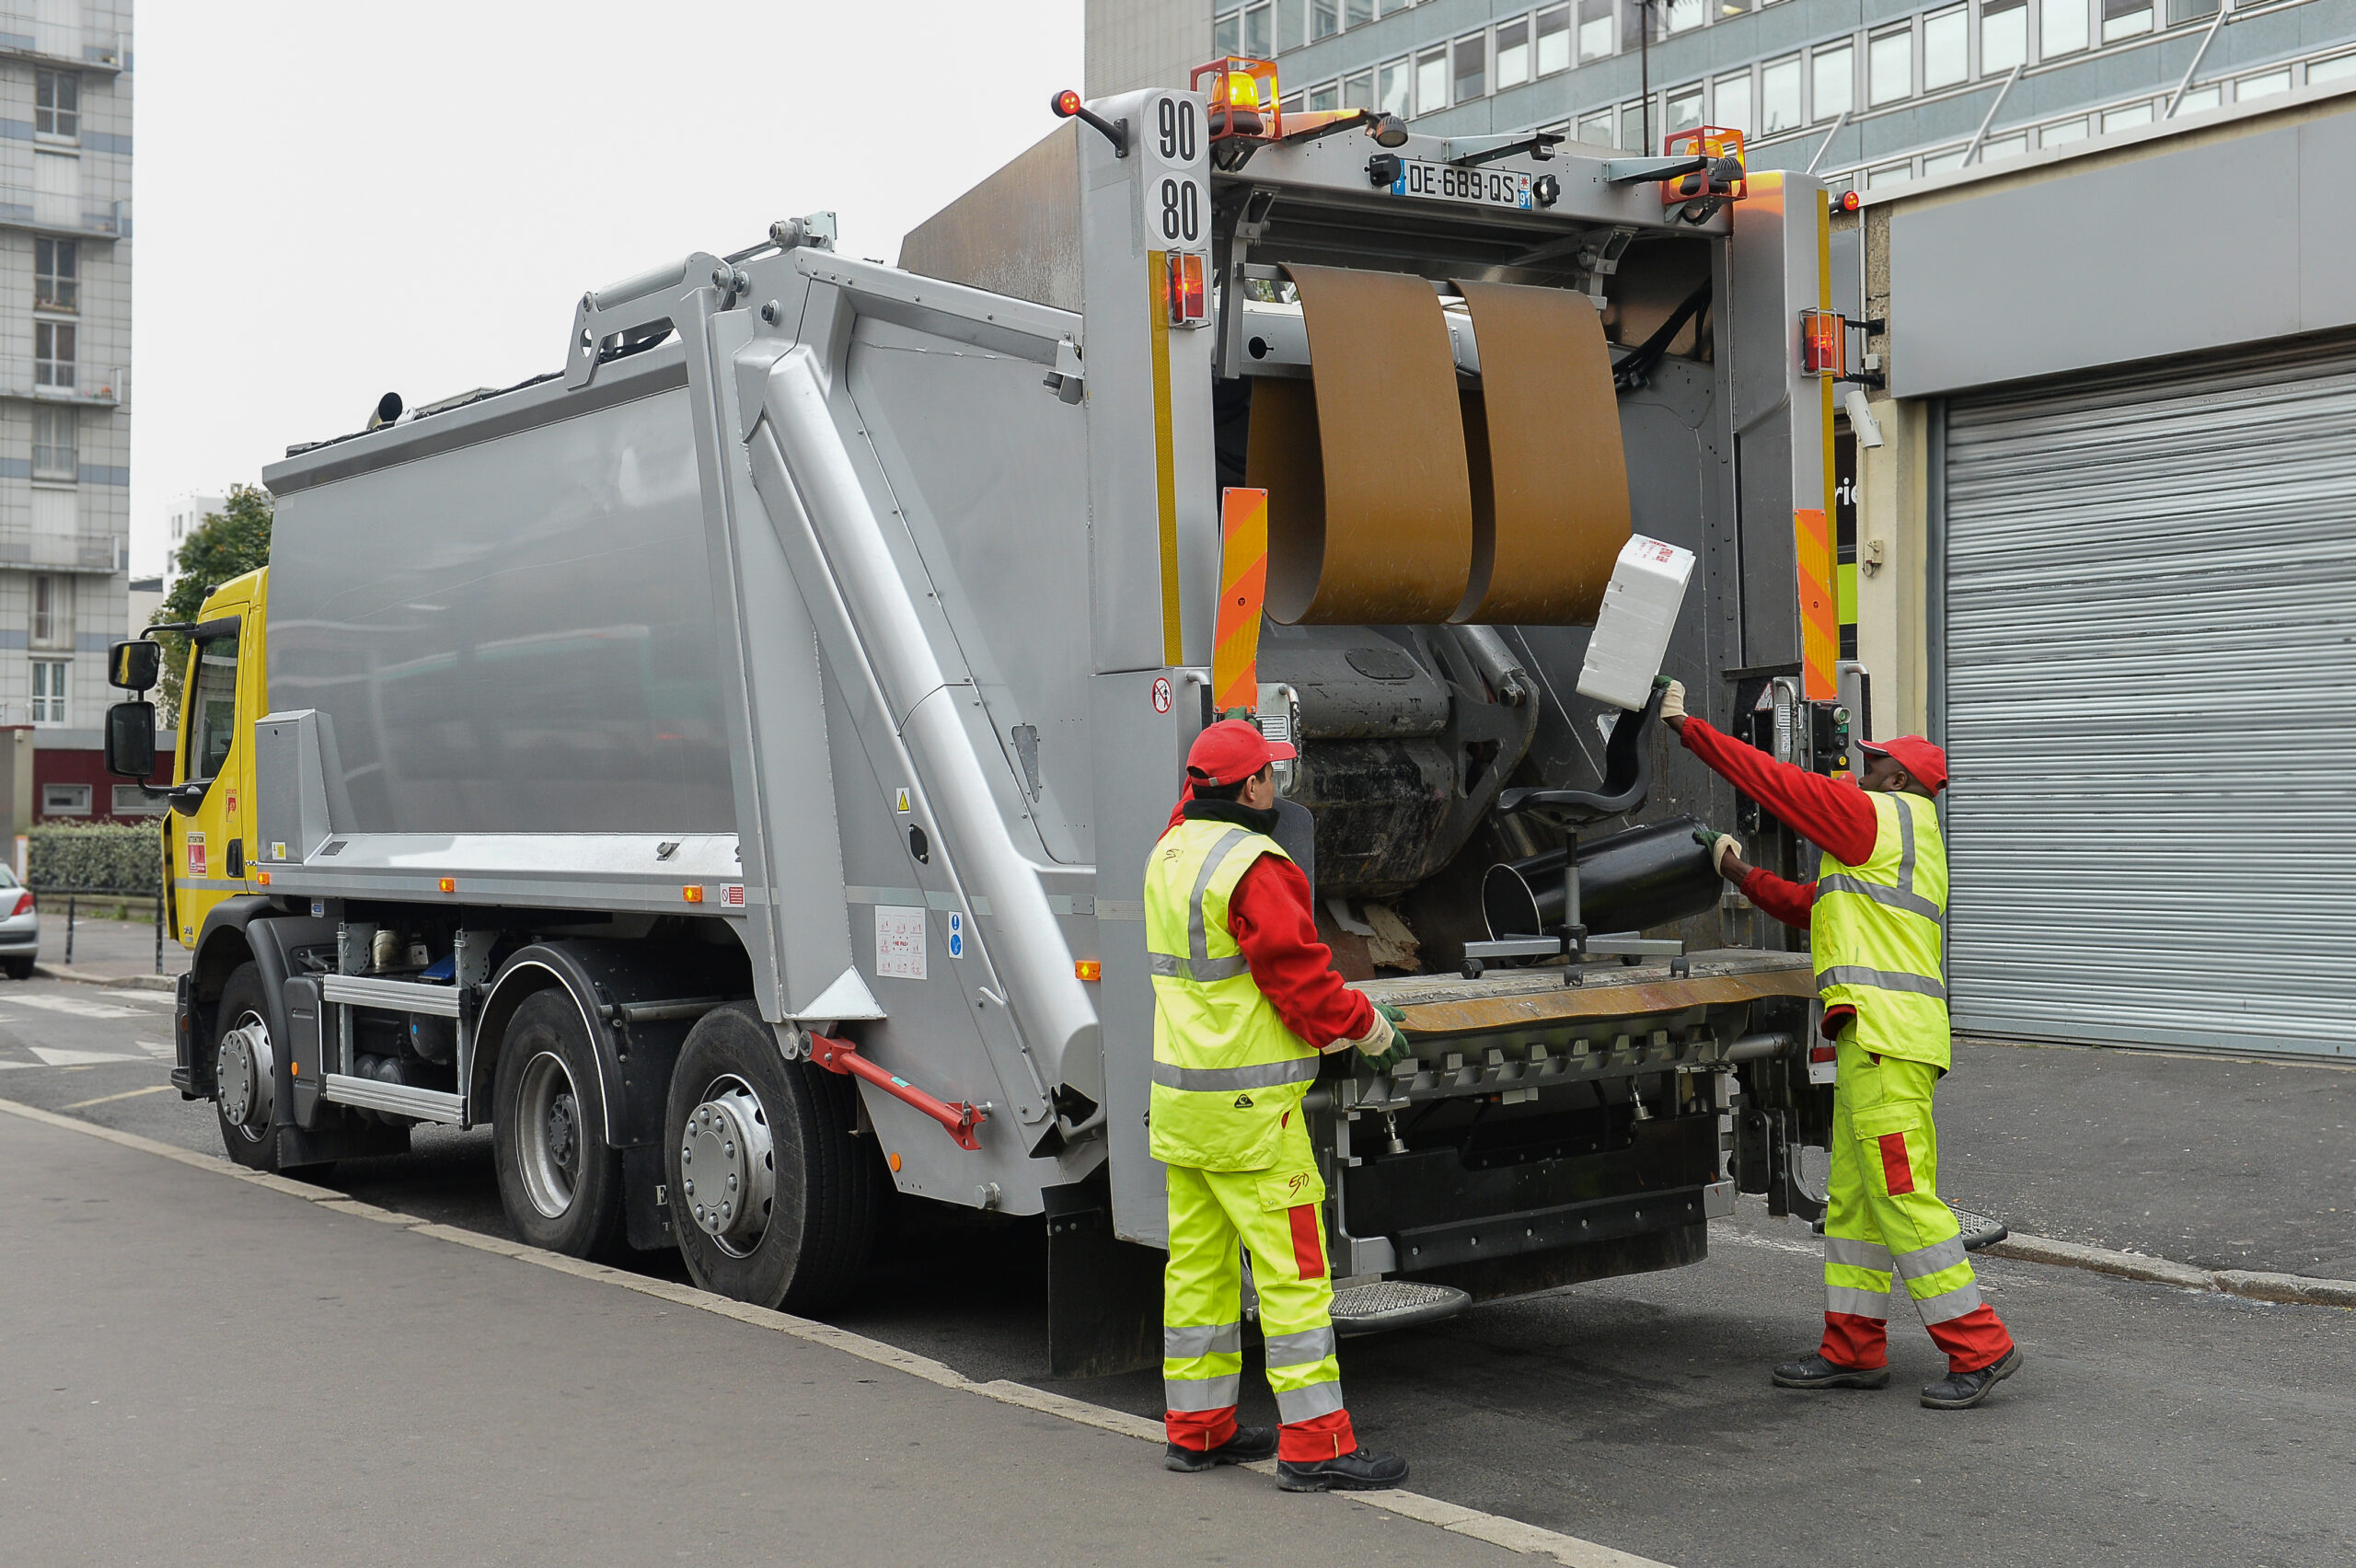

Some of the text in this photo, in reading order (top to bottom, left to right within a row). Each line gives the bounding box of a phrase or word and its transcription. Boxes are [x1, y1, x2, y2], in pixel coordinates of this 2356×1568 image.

[1159, 98, 1195, 162] 90
[1396, 180, 1402, 189] F
[1409, 165, 1515, 203] DE-689-QS
[1519, 192, 1530, 206] 91
[1161, 179, 1198, 242] 80
